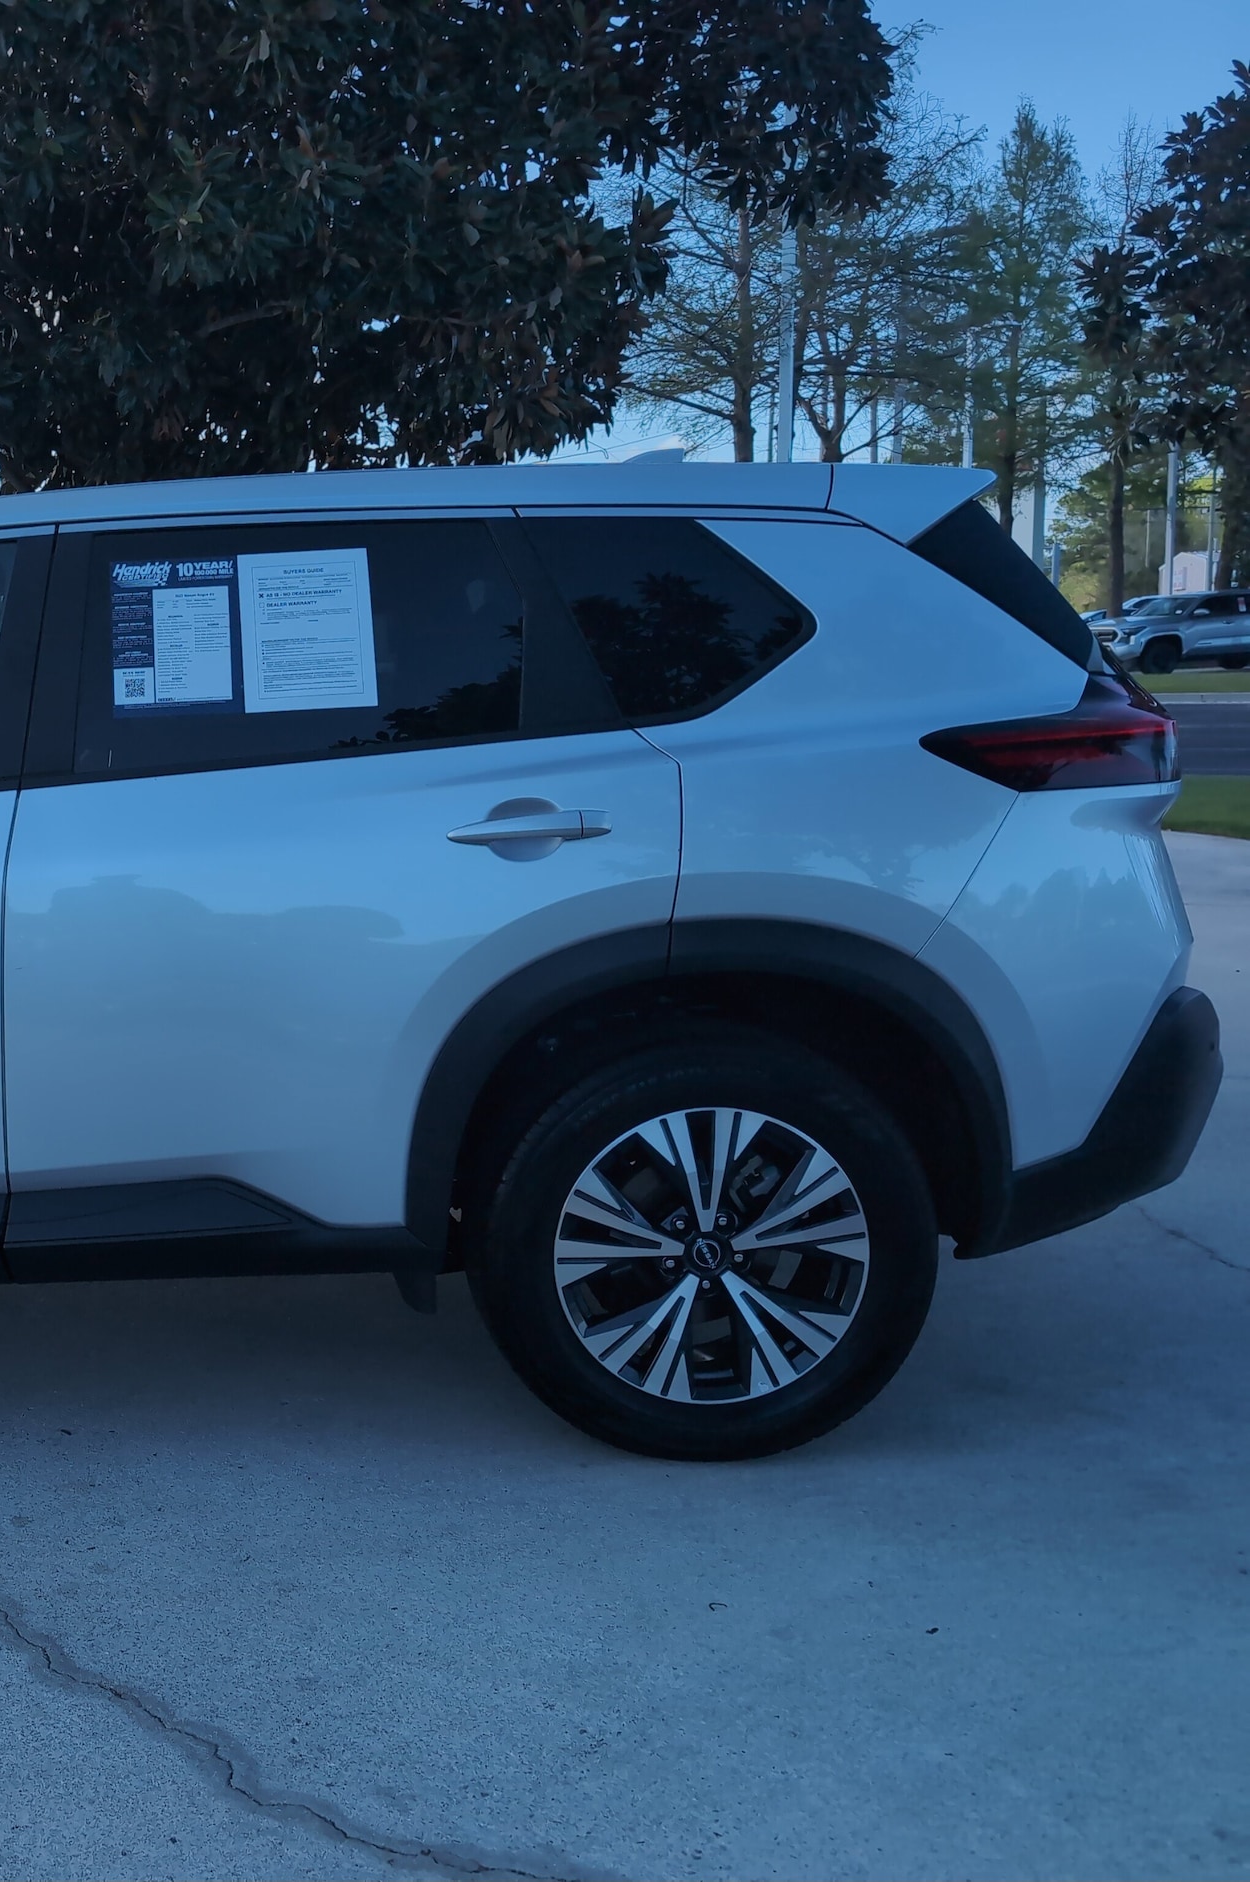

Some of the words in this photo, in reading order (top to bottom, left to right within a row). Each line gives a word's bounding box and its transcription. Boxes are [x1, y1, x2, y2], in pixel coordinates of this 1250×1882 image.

[112, 562, 172, 581] Hendrick
[176, 562, 193, 577] 10
[218, 567, 234, 575] MILE
[696, 1238, 716, 1269] NISSAN
